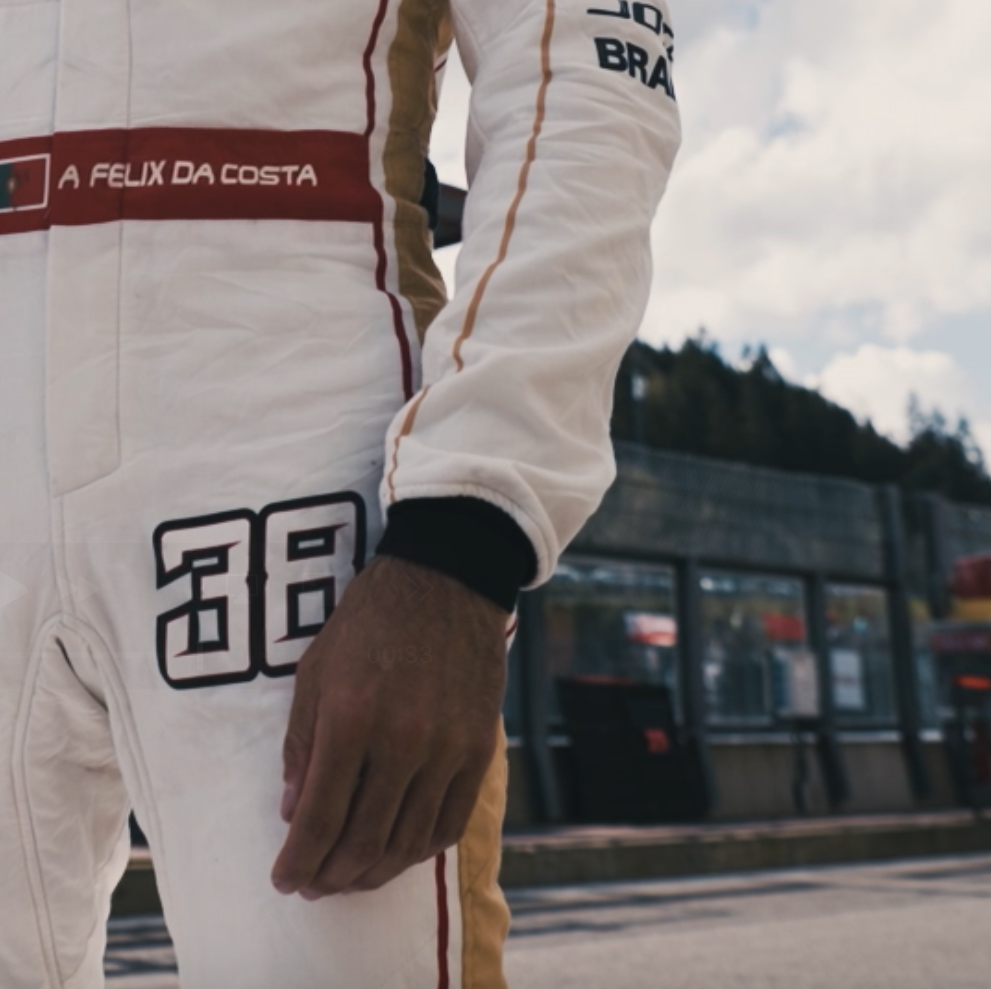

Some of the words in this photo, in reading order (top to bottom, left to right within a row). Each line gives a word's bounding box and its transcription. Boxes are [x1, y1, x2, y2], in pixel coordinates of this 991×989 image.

[594, 37, 676, 101] BRA
[58, 164, 80, 189] A
[89, 160, 167, 188] FELIX
[170, 160, 215, 186] DA
[220, 163, 318, 187] COSTA
[152, 490, 367, 690] 38
